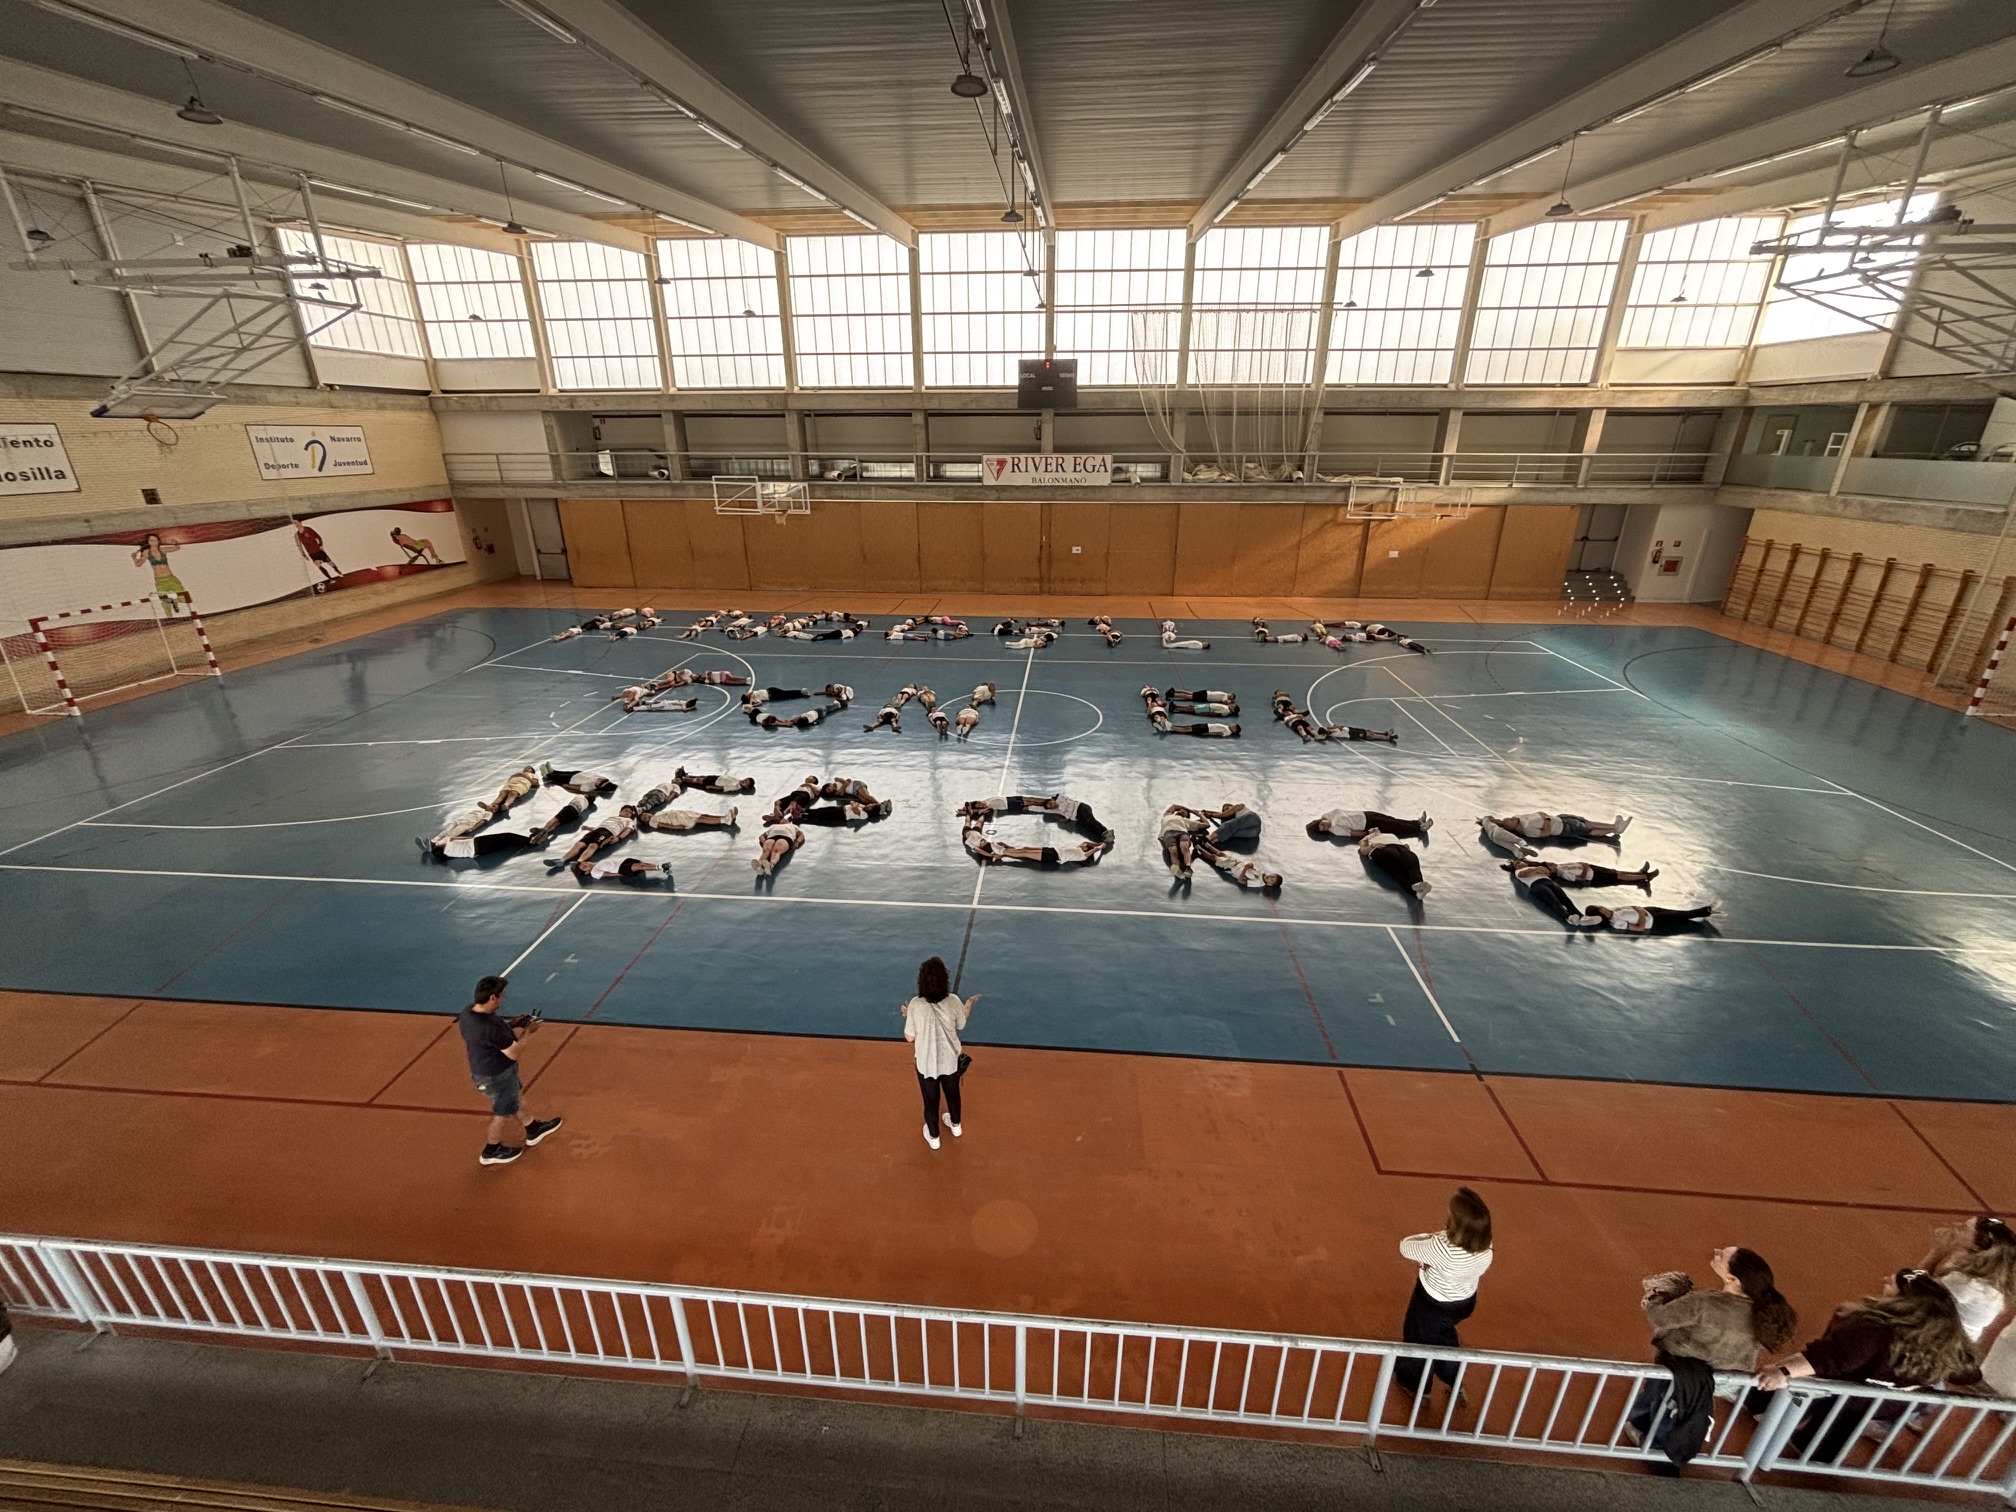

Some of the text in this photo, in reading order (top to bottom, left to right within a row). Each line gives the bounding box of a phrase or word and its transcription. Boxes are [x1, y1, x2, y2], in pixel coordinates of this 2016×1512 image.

[0, 437, 54, 449] iento
[255, 435, 362, 443] Instituto Navarro
[264, 459, 368, 471] Deporte Juventud
[1010, 456, 1109, 474] RIVER EGA
[0, 467, 67, 483] osilla
